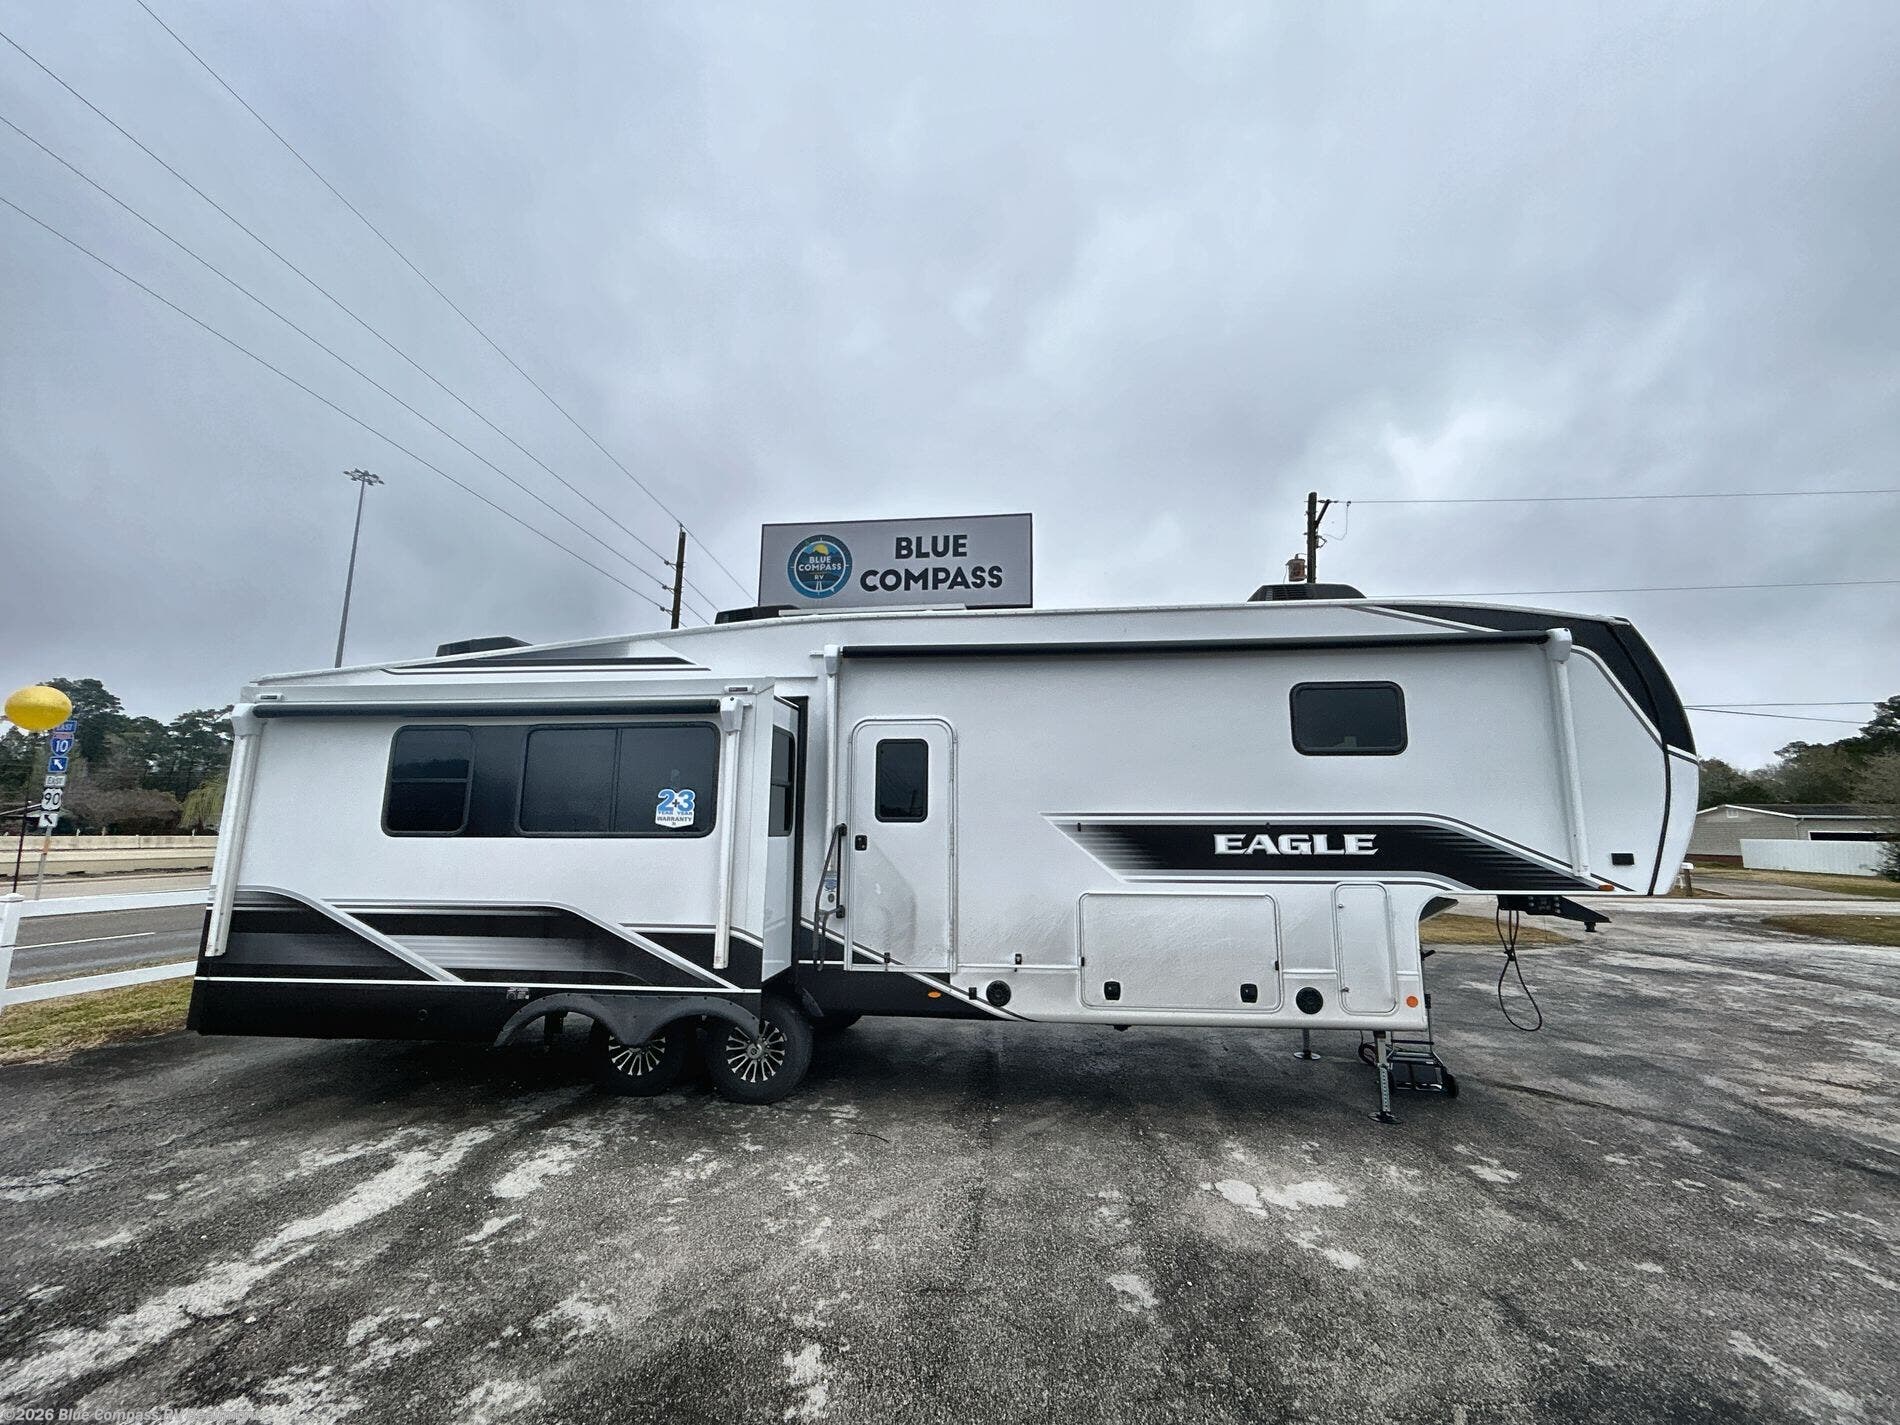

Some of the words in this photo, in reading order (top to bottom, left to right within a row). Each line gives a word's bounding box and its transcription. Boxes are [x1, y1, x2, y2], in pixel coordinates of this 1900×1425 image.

[895, 534, 968, 559] BLUE
[809, 555, 832, 563] BLUE
[798, 563, 842, 571] COMPASS
[860, 565, 1003, 592] COMPASS
[55, 740, 69, 753] 10
[44, 792, 60, 806] 90
[1213, 833, 1378, 855] EAGLE
